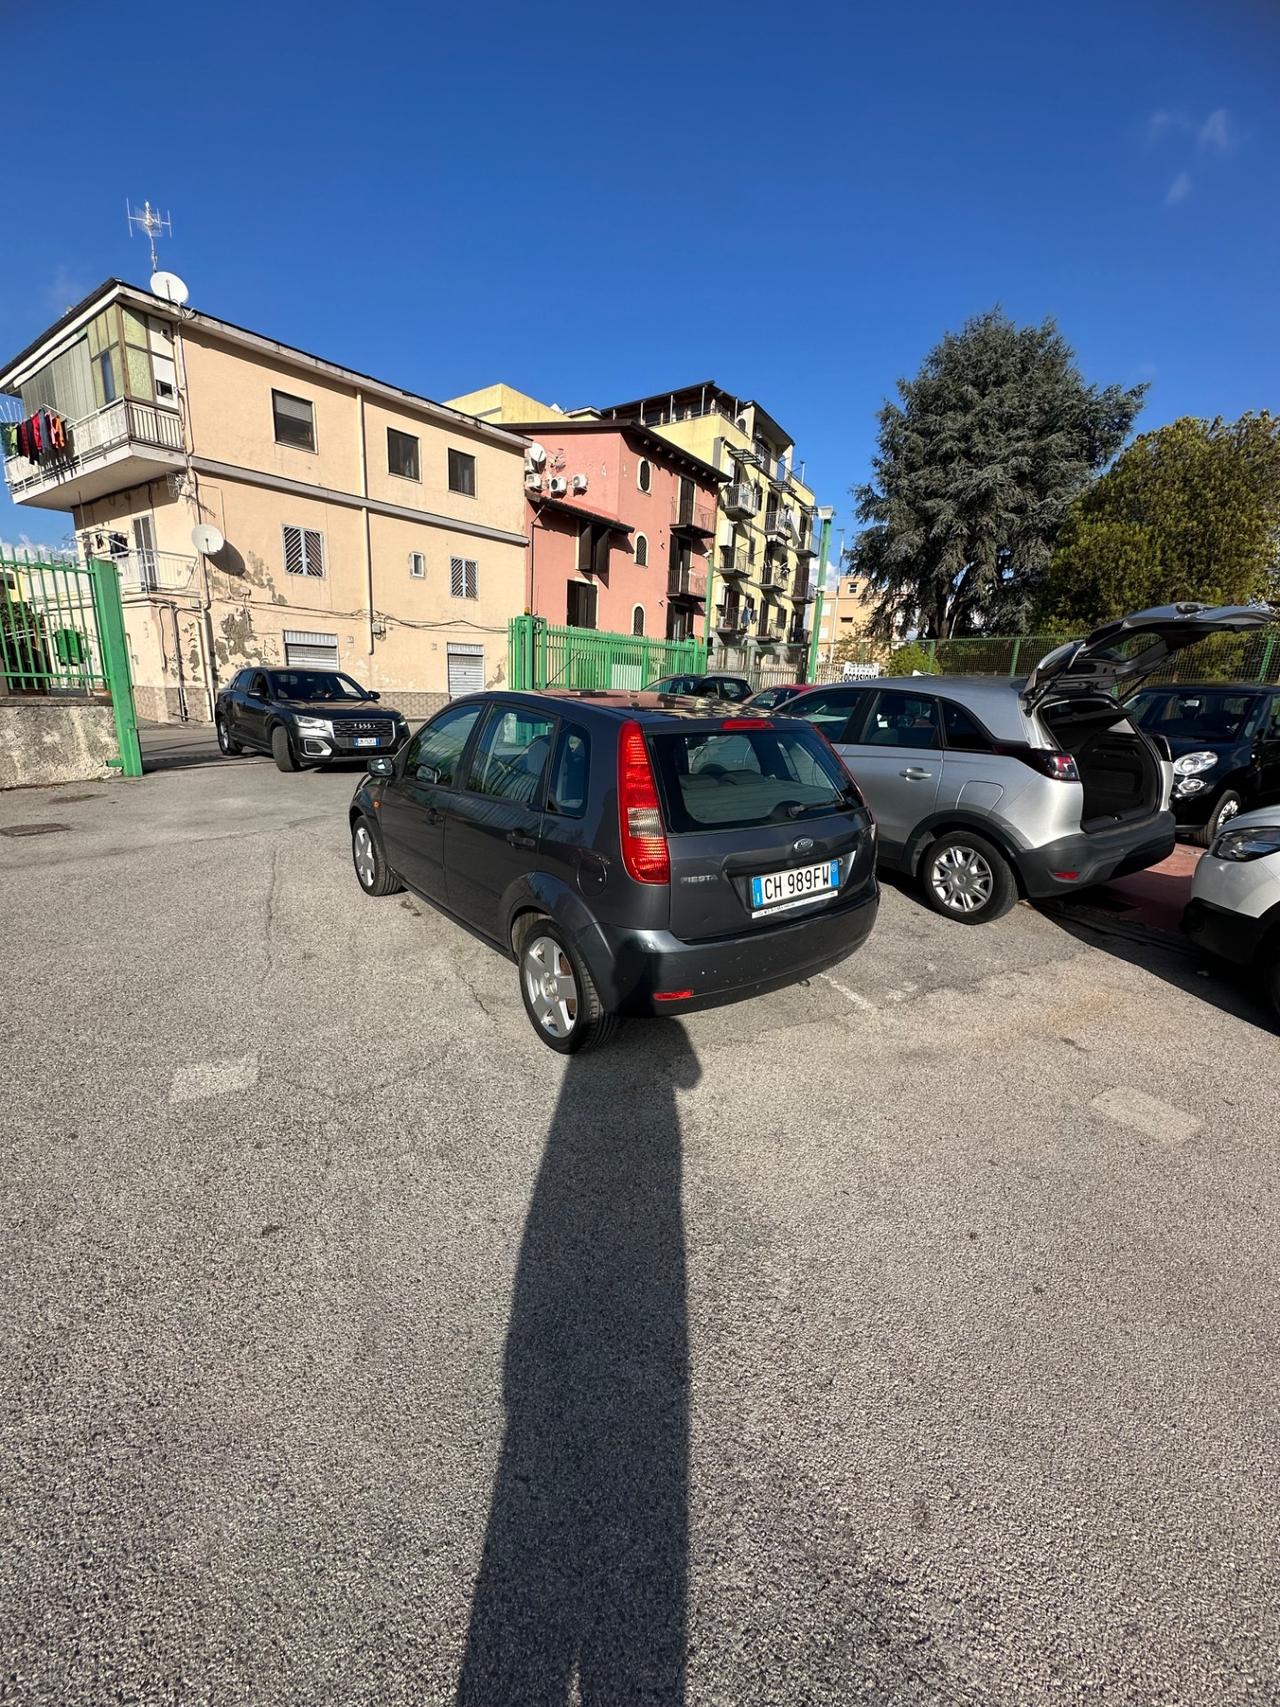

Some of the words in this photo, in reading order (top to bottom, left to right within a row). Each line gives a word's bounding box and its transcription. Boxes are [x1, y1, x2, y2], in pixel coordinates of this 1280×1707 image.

[680, 874, 719, 884] FIESTA
[764, 878, 783, 900] CH
[788, 865, 830, 895] 989FW
